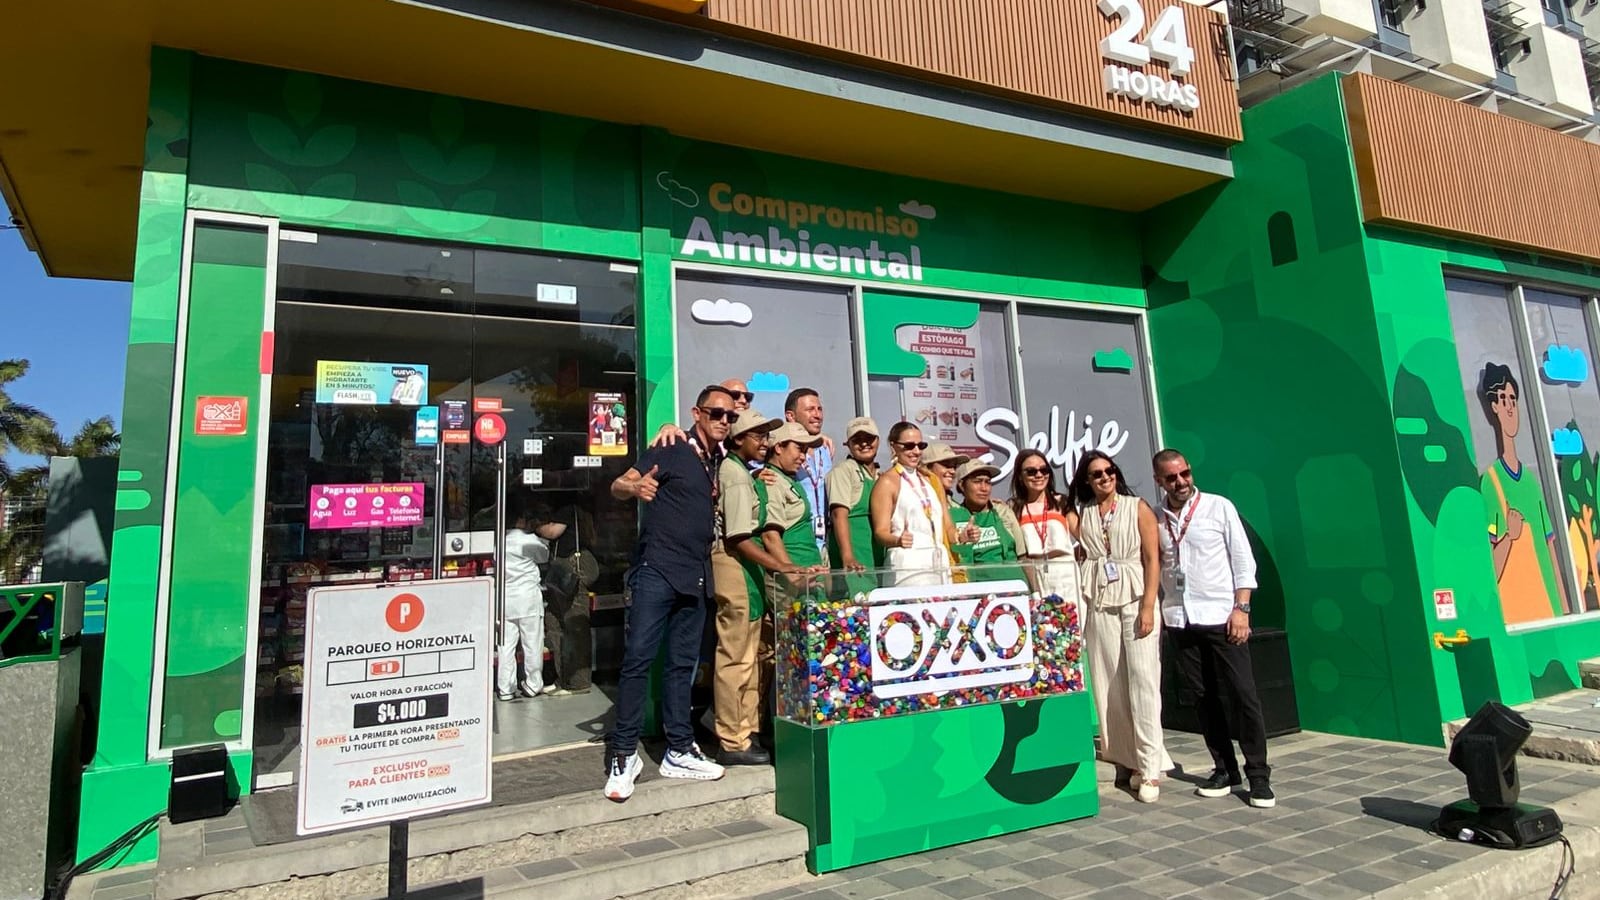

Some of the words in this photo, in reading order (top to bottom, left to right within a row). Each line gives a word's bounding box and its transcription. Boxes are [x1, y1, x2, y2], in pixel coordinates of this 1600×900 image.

[1098, 0, 1194, 74] 24
[1105, 64, 1199, 110] HORAS
[708, 182, 919, 238] Compromiso
[680, 216, 923, 281] Ambiental
[921, 332, 964, 345] ESTÓMAGO
[976, 405, 1130, 487] Selfie
[322, 486, 344, 496] Paga
[345, 486, 364, 496] aquí
[365, 486, 378, 494] tus
[380, 484, 414, 494] facturas
[312, 510, 332, 518] Agua
[389, 507, 420, 515] Telefonía
[400, 602, 411, 624] P
[328, 642, 392, 658] PARQUEO
[396, 634, 476, 651] HORIZONTAL
[875, 596, 1028, 679] OXXO
[350, 691, 378, 700] VALOR
[380, 688, 403, 697] HORA
[414, 682, 453, 693] FRACCIÓN
[378, 698, 427, 724] $4.000
[316, 735, 347, 748] GRATIS
[349, 734, 360, 742] LA
[362, 728, 399, 741] PRIMERA
[400, 726, 424, 736] HORA
[426, 717, 481, 731] PRESENTANDO
[340, 745, 351, 754] TU
[354, 741, 386, 752] TIQUETE
[388, 740, 399, 748] DE
[402, 733, 436, 746] COMPRA
[373, 759, 428, 775] EXCLUSIVO
[348, 777, 376, 789] PARA
[380, 770, 426, 785] CLIENTES
[367, 798, 389, 809] EVITE
[391, 786, 457, 805] INMOVILIZACIÓN
